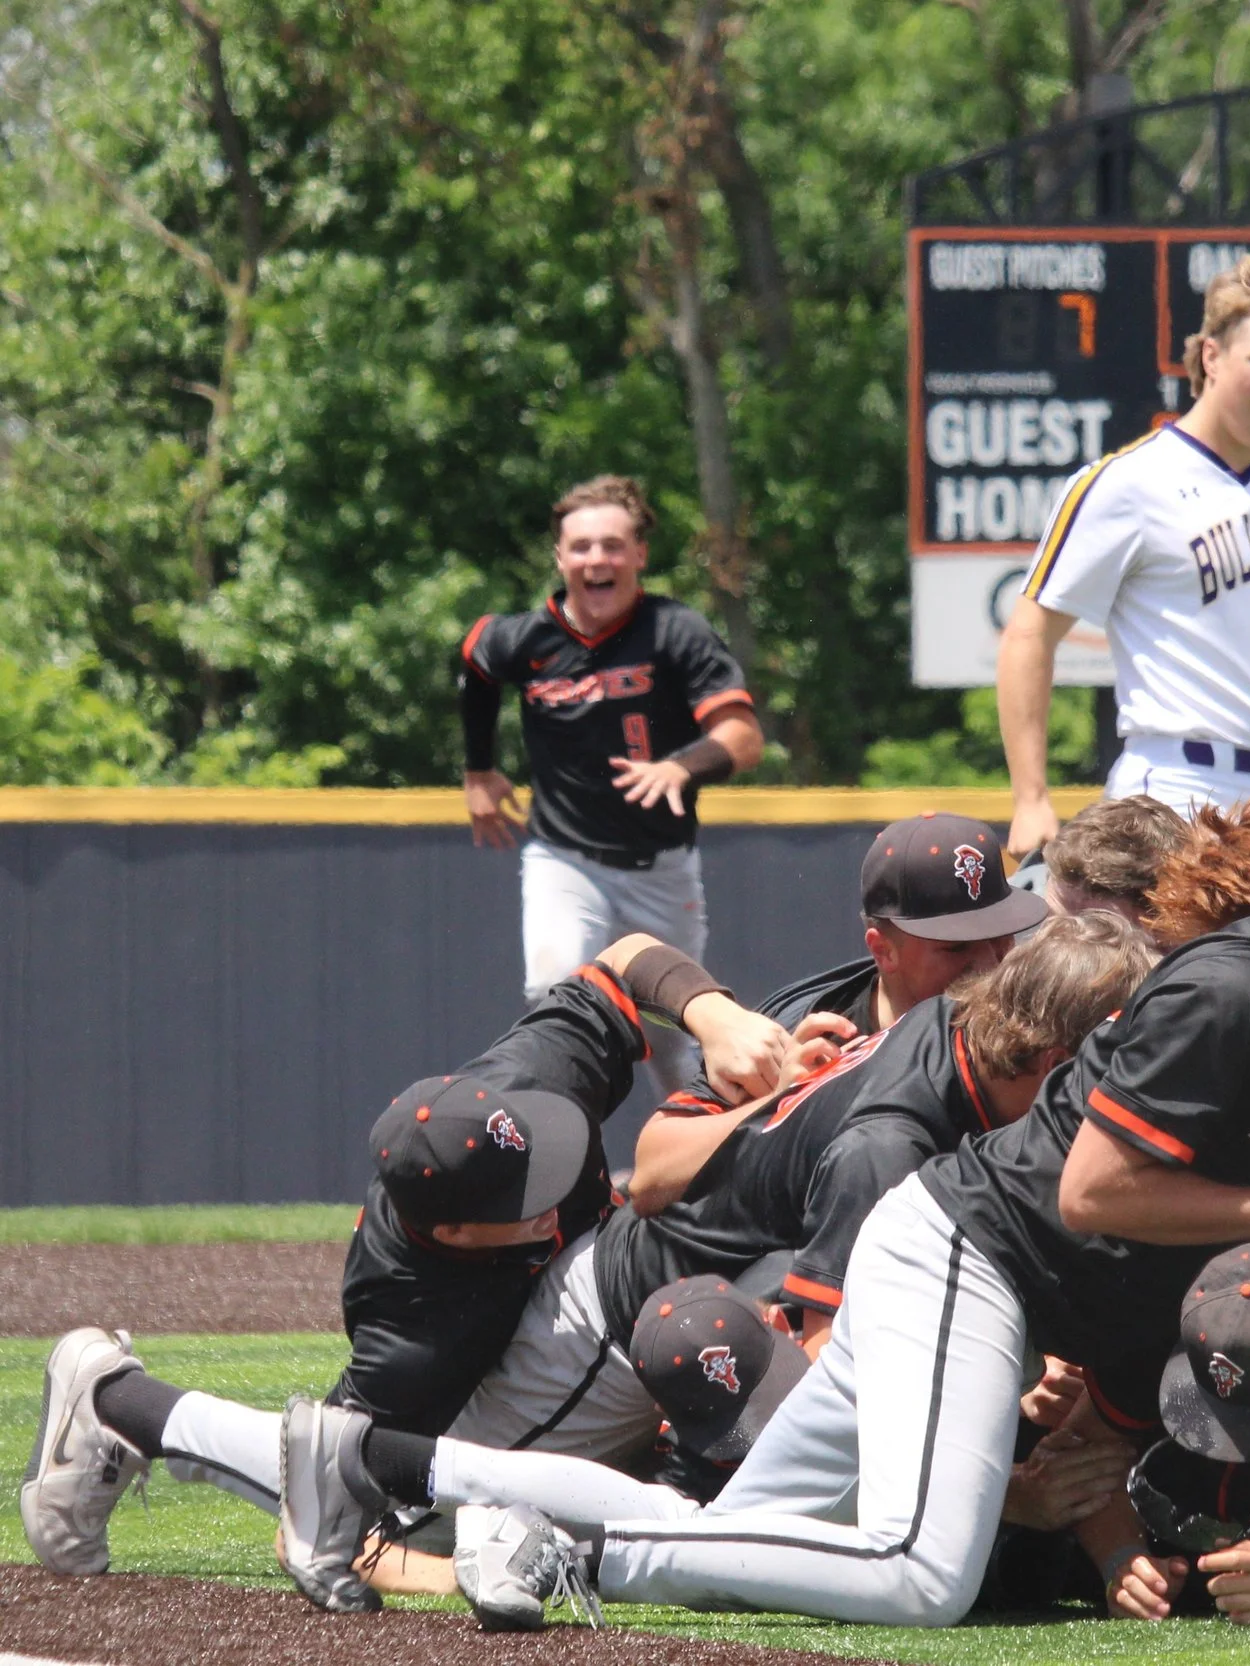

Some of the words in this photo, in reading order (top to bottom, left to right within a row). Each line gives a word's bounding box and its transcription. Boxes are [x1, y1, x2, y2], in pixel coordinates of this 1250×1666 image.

[929, 242, 1004, 291] GUEST
[1006, 242, 1106, 292] PITCHES
[1057, 293, 1097, 357] 7
[927, 398, 1112, 468] GUEST
[936, 474, 1067, 542] HOM
[621, 712, 653, 762] 9
